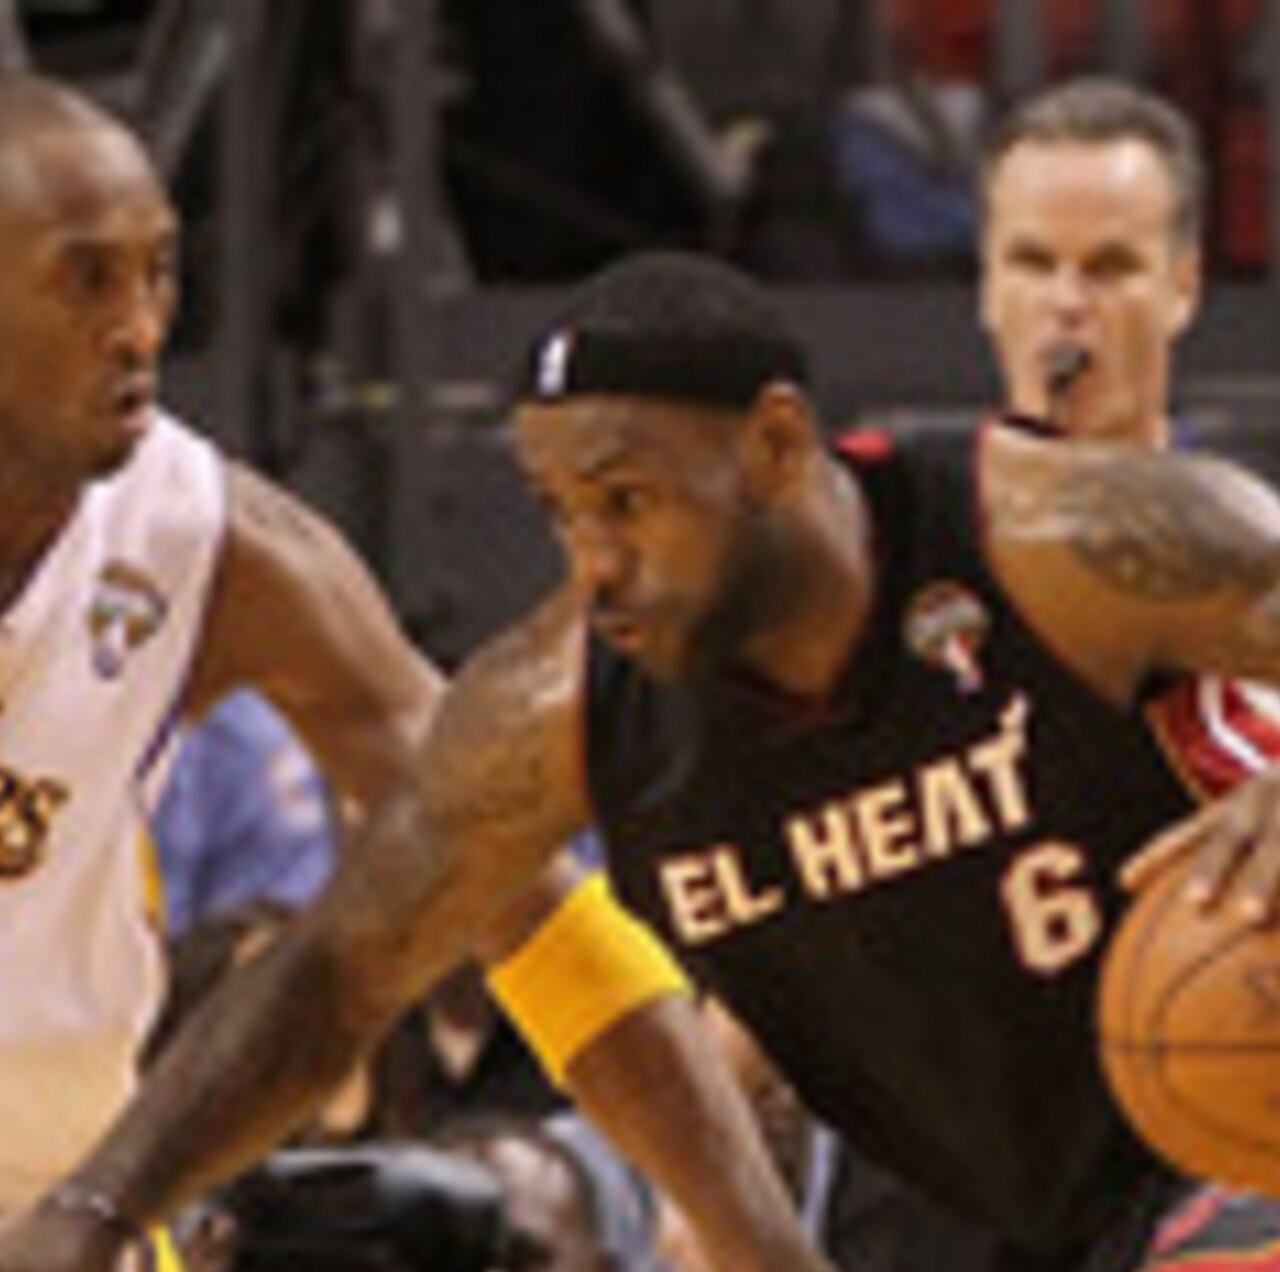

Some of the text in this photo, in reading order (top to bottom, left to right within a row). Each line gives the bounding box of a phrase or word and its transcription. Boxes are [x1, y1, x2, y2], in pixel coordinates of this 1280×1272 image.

[656, 692, 1032, 944] EL HEAT
[1000, 838, 1103, 980] 6
